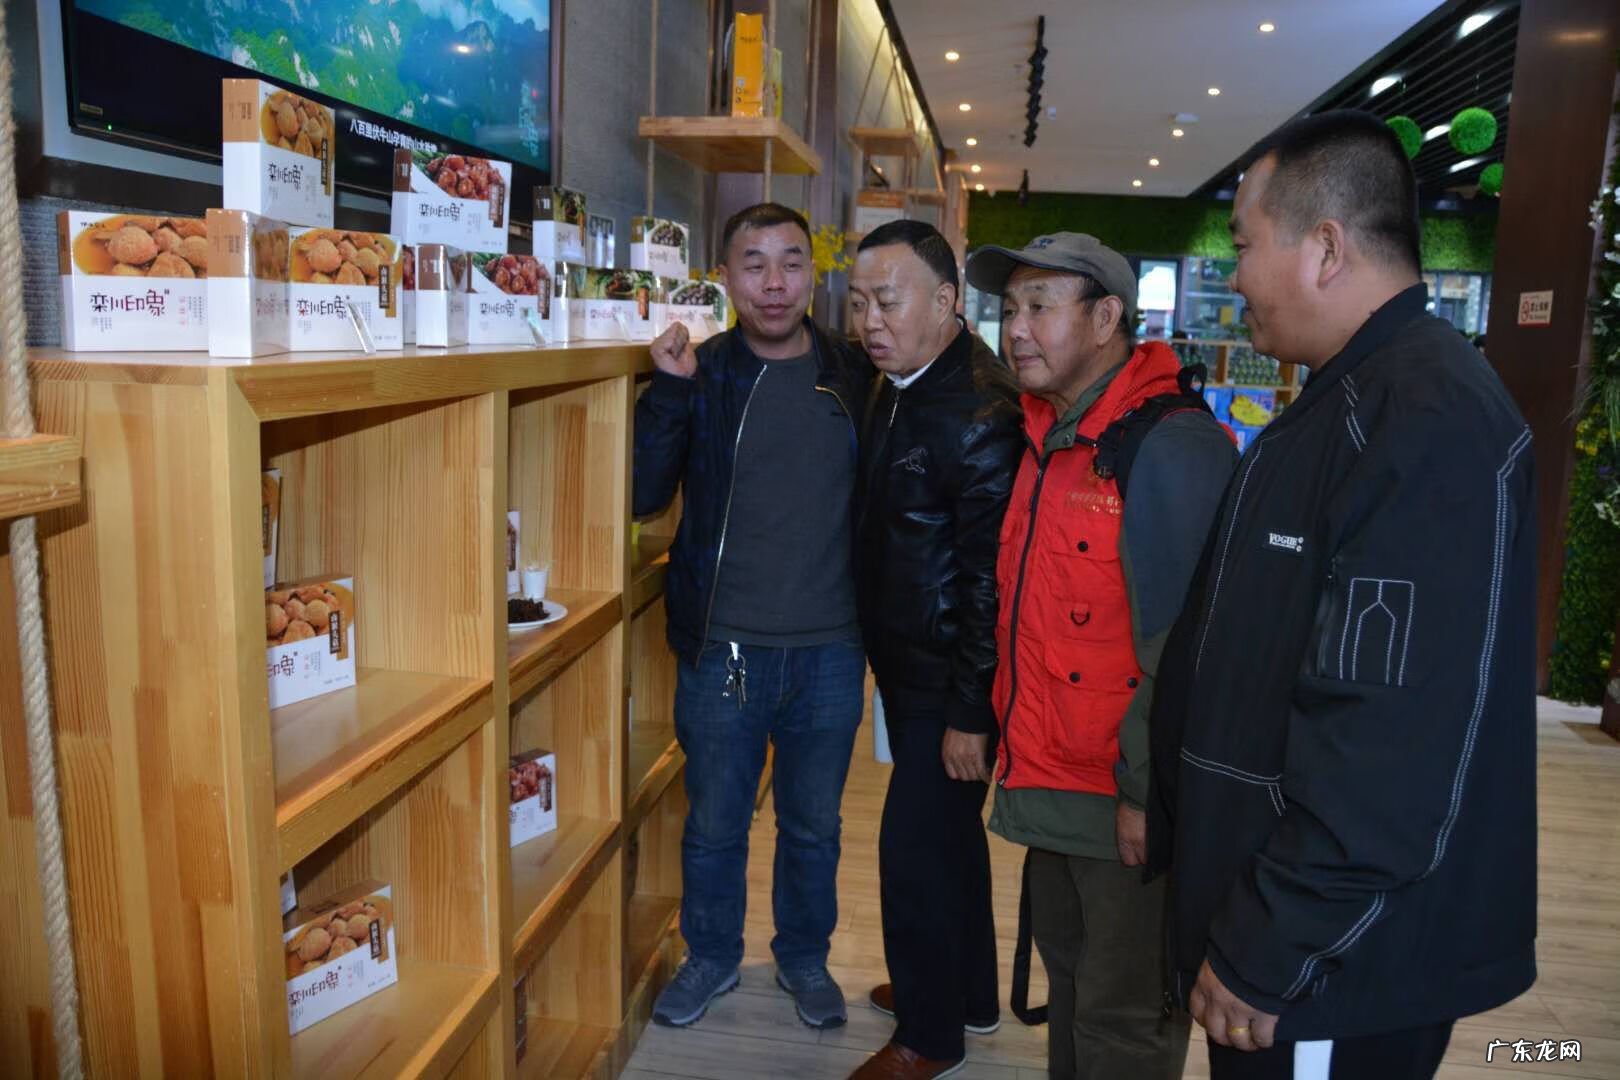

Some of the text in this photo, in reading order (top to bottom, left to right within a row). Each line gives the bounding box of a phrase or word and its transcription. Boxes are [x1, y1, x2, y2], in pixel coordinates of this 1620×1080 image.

[268, 162, 301, 192] 栾川印象
[90, 288, 165, 317] 栾川印象
[296, 294, 347, 320] 栾川印象
